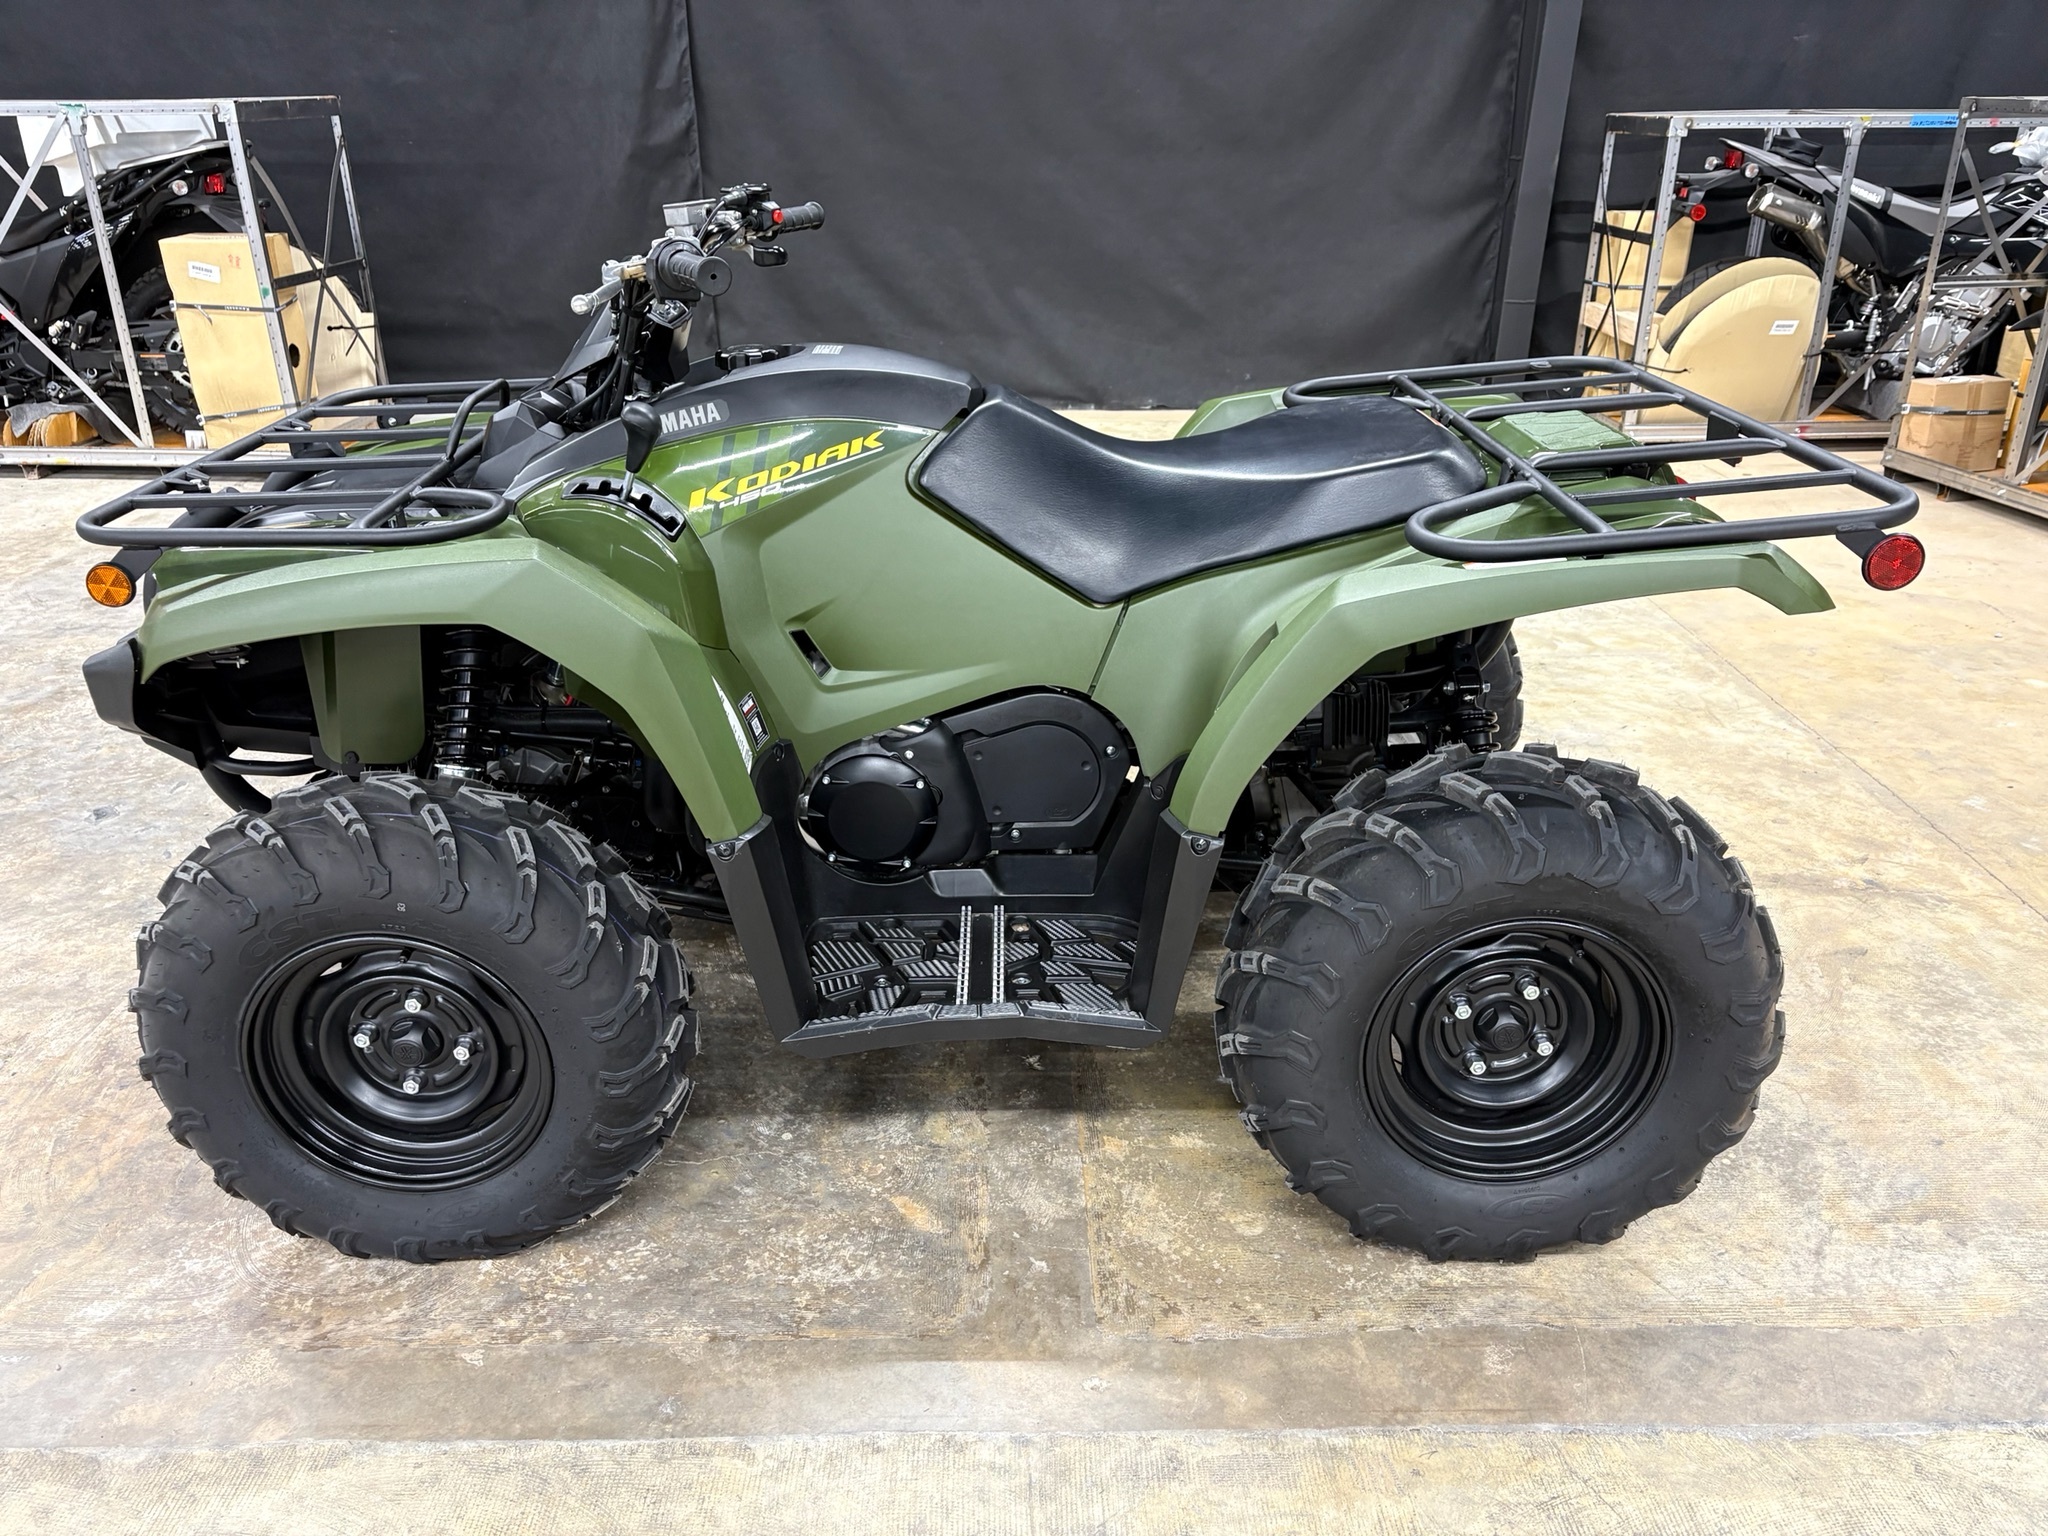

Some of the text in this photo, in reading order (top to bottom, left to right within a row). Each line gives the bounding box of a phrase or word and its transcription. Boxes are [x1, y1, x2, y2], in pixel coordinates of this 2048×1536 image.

[1851, 184, 1881, 203] awasaki
[660, 402, 721, 434] MAHA
[689, 430, 885, 512] KODIAK
[719, 482, 782, 509] 450
